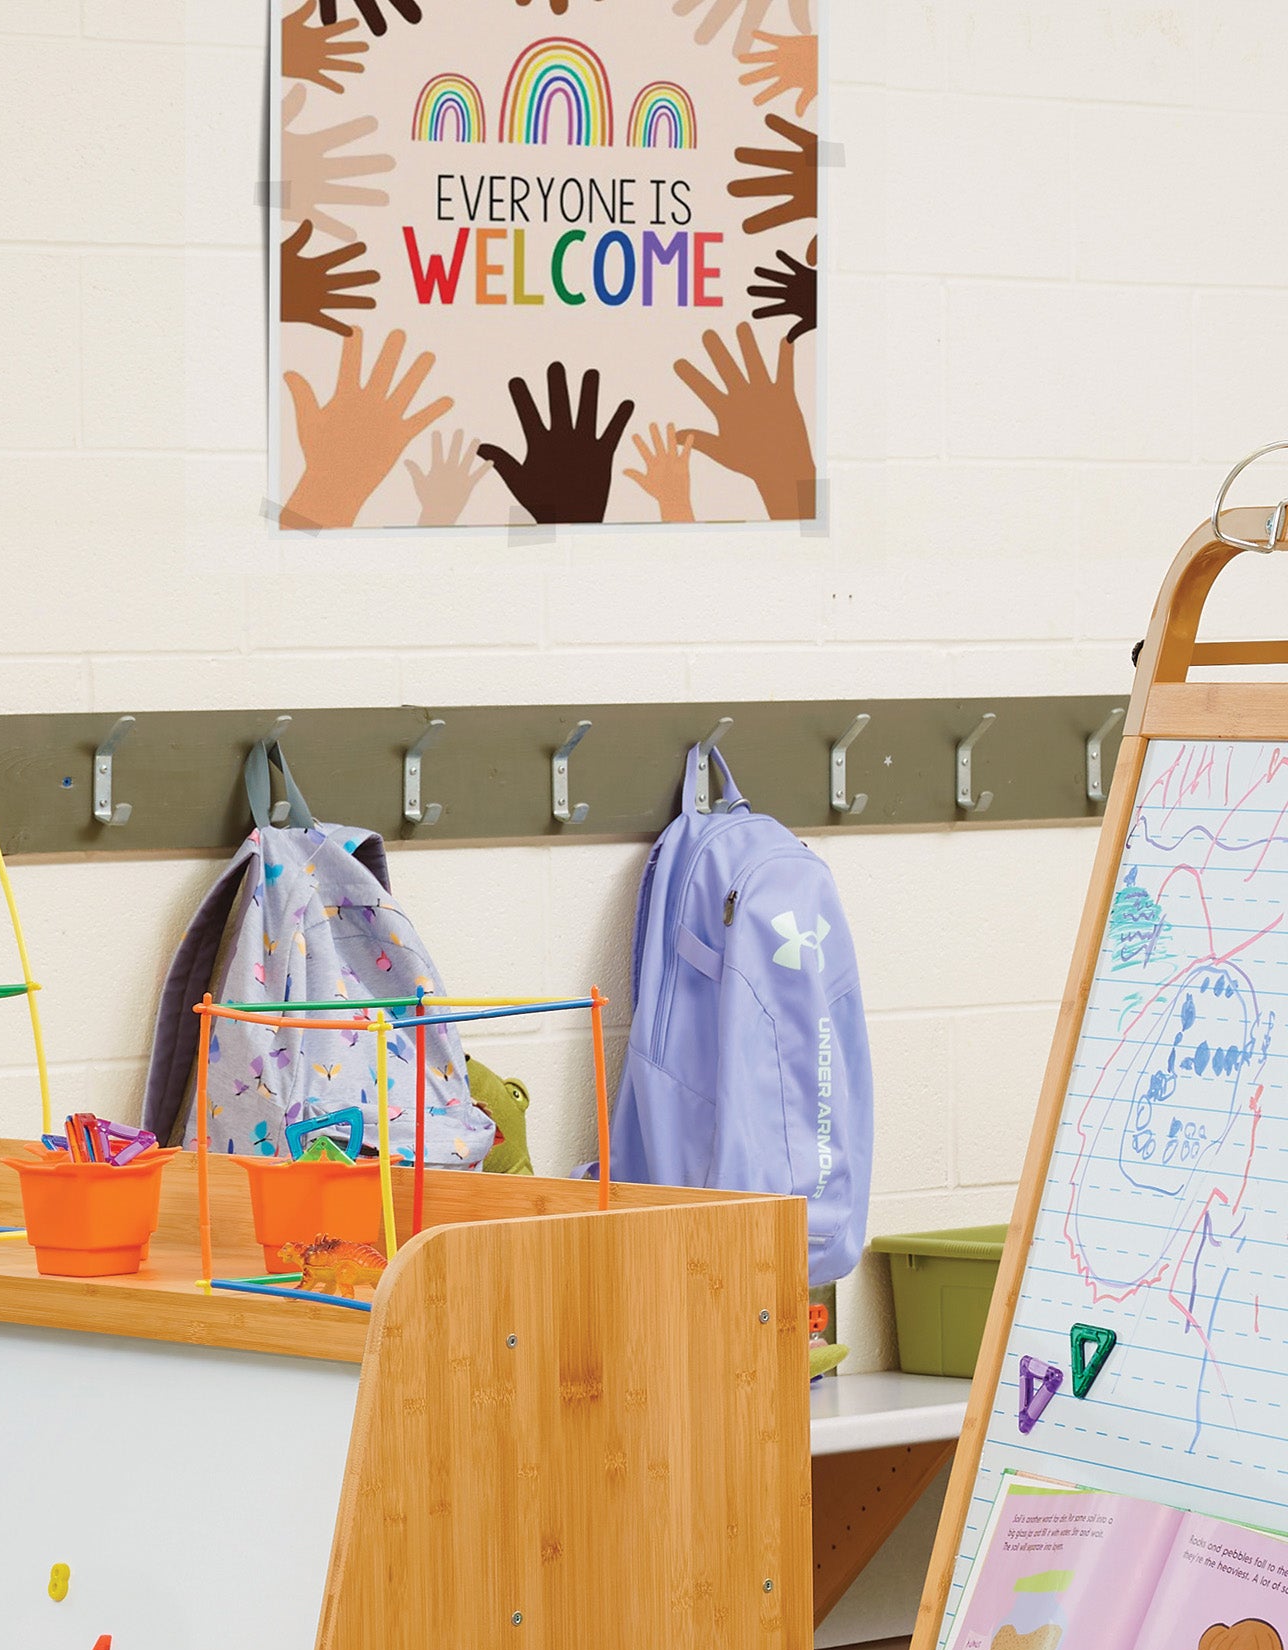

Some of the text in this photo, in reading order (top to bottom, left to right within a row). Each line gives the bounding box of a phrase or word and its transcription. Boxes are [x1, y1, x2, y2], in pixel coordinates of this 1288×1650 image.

[436, 174, 693, 225] EVERYONE IS
[402, 226, 724, 308] WELCOME
[812, 1016, 833, 1200] UNDER ARMOUR
[1204, 1556, 1216, 1568] the
[1216, 1561, 1250, 1580] heaviest.
[1251, 1574, 1259, 1583] A
[1260, 1576, 1271, 1587] lot
[1271, 1581, 1281, 1590] of
[1207, 1543, 1223, 1553] and
[1221, 1548, 1253, 1565] pebbles
[1253, 1556, 1267, 1569] fall
[1267, 1563, 1276, 1572] to
[48, 1562, 71, 1602] 8
